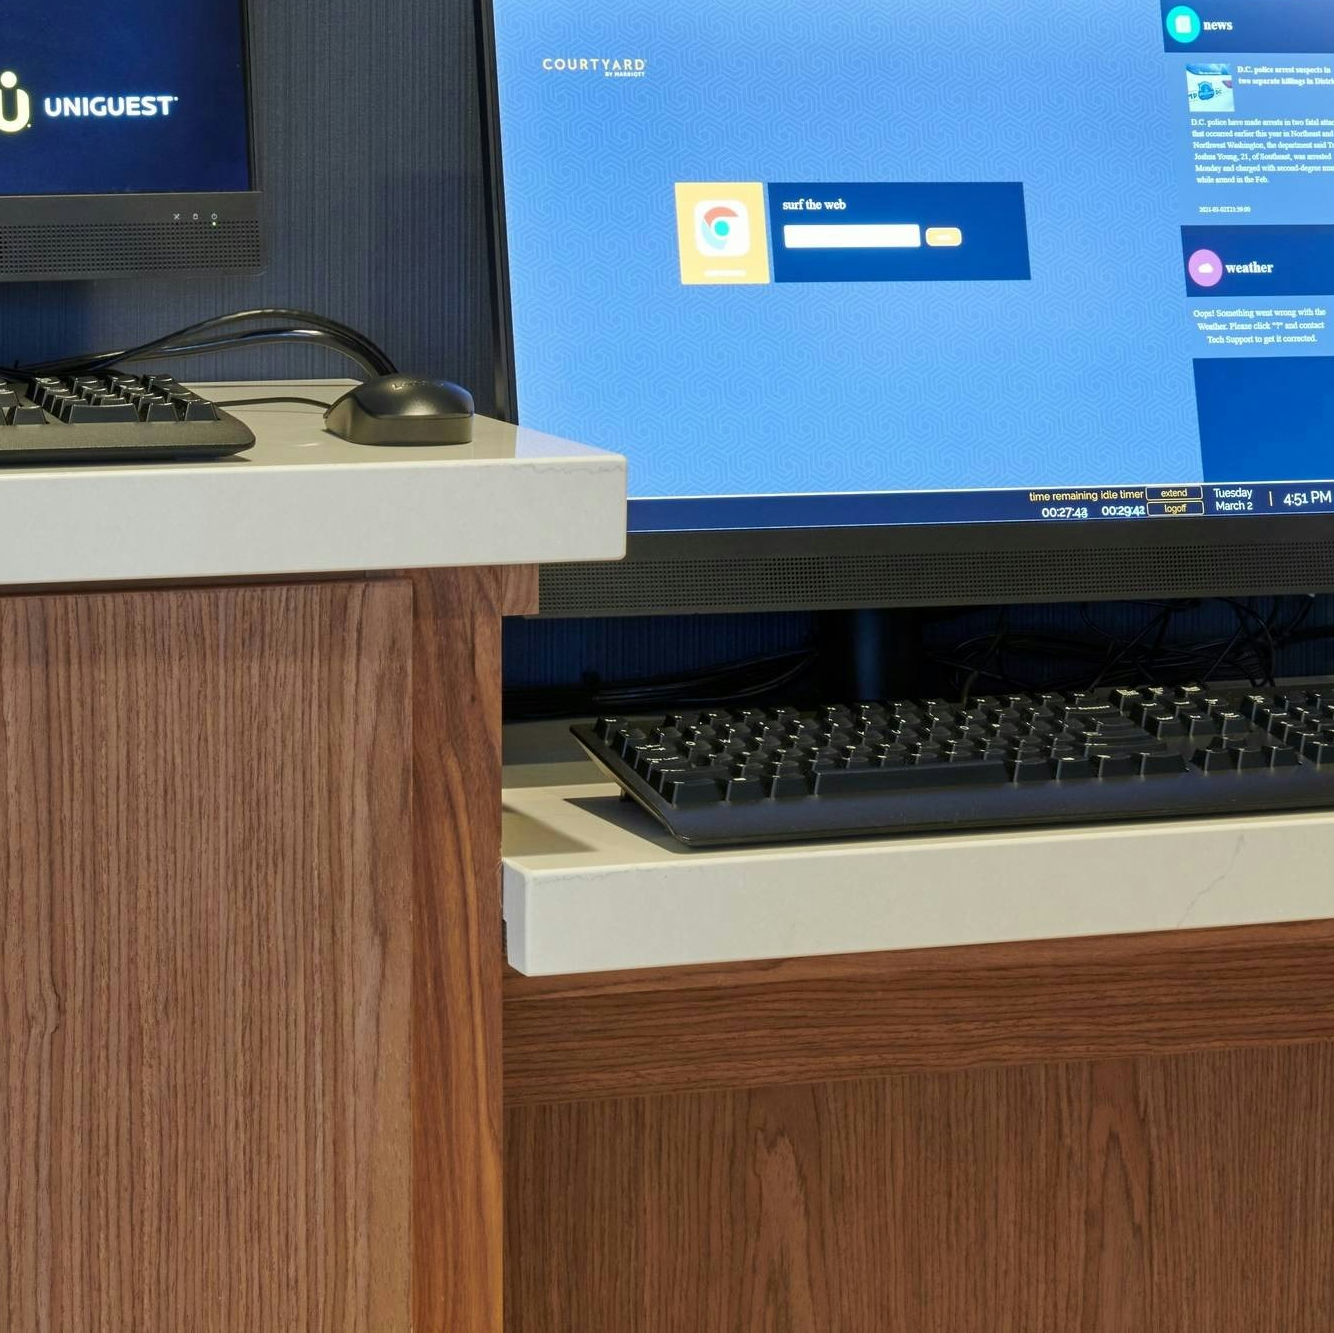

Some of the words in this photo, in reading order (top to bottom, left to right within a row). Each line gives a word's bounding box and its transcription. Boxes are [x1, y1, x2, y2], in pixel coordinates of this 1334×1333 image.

[1202, 21, 1234, 31] news
[542, 58, 645, 71] COURTYARD
[44, 96, 174, 117] UNIGUEST
[782, 198, 805, 210] surf
[805, 198, 822, 210] the
[823, 198, 847, 210] web
[1225, 261, 1274, 273] weather
[1028, 491, 1051, 501] time
[1052, 490, 1099, 502] remaining
[1100, 490, 1118, 500] idle
[1119, 489, 1144, 499] timer
[1160, 488, 1188, 498] extend
[1213, 487, 1253, 500] Tuesday
[1282, 493, 1309, 507] 4:51
[1310, 490, 1333, 504] PM
[1164, 504, 1188, 515] logoff
[1215, 500, 1246, 511] March
[1246, 501, 1254, 511] 2
